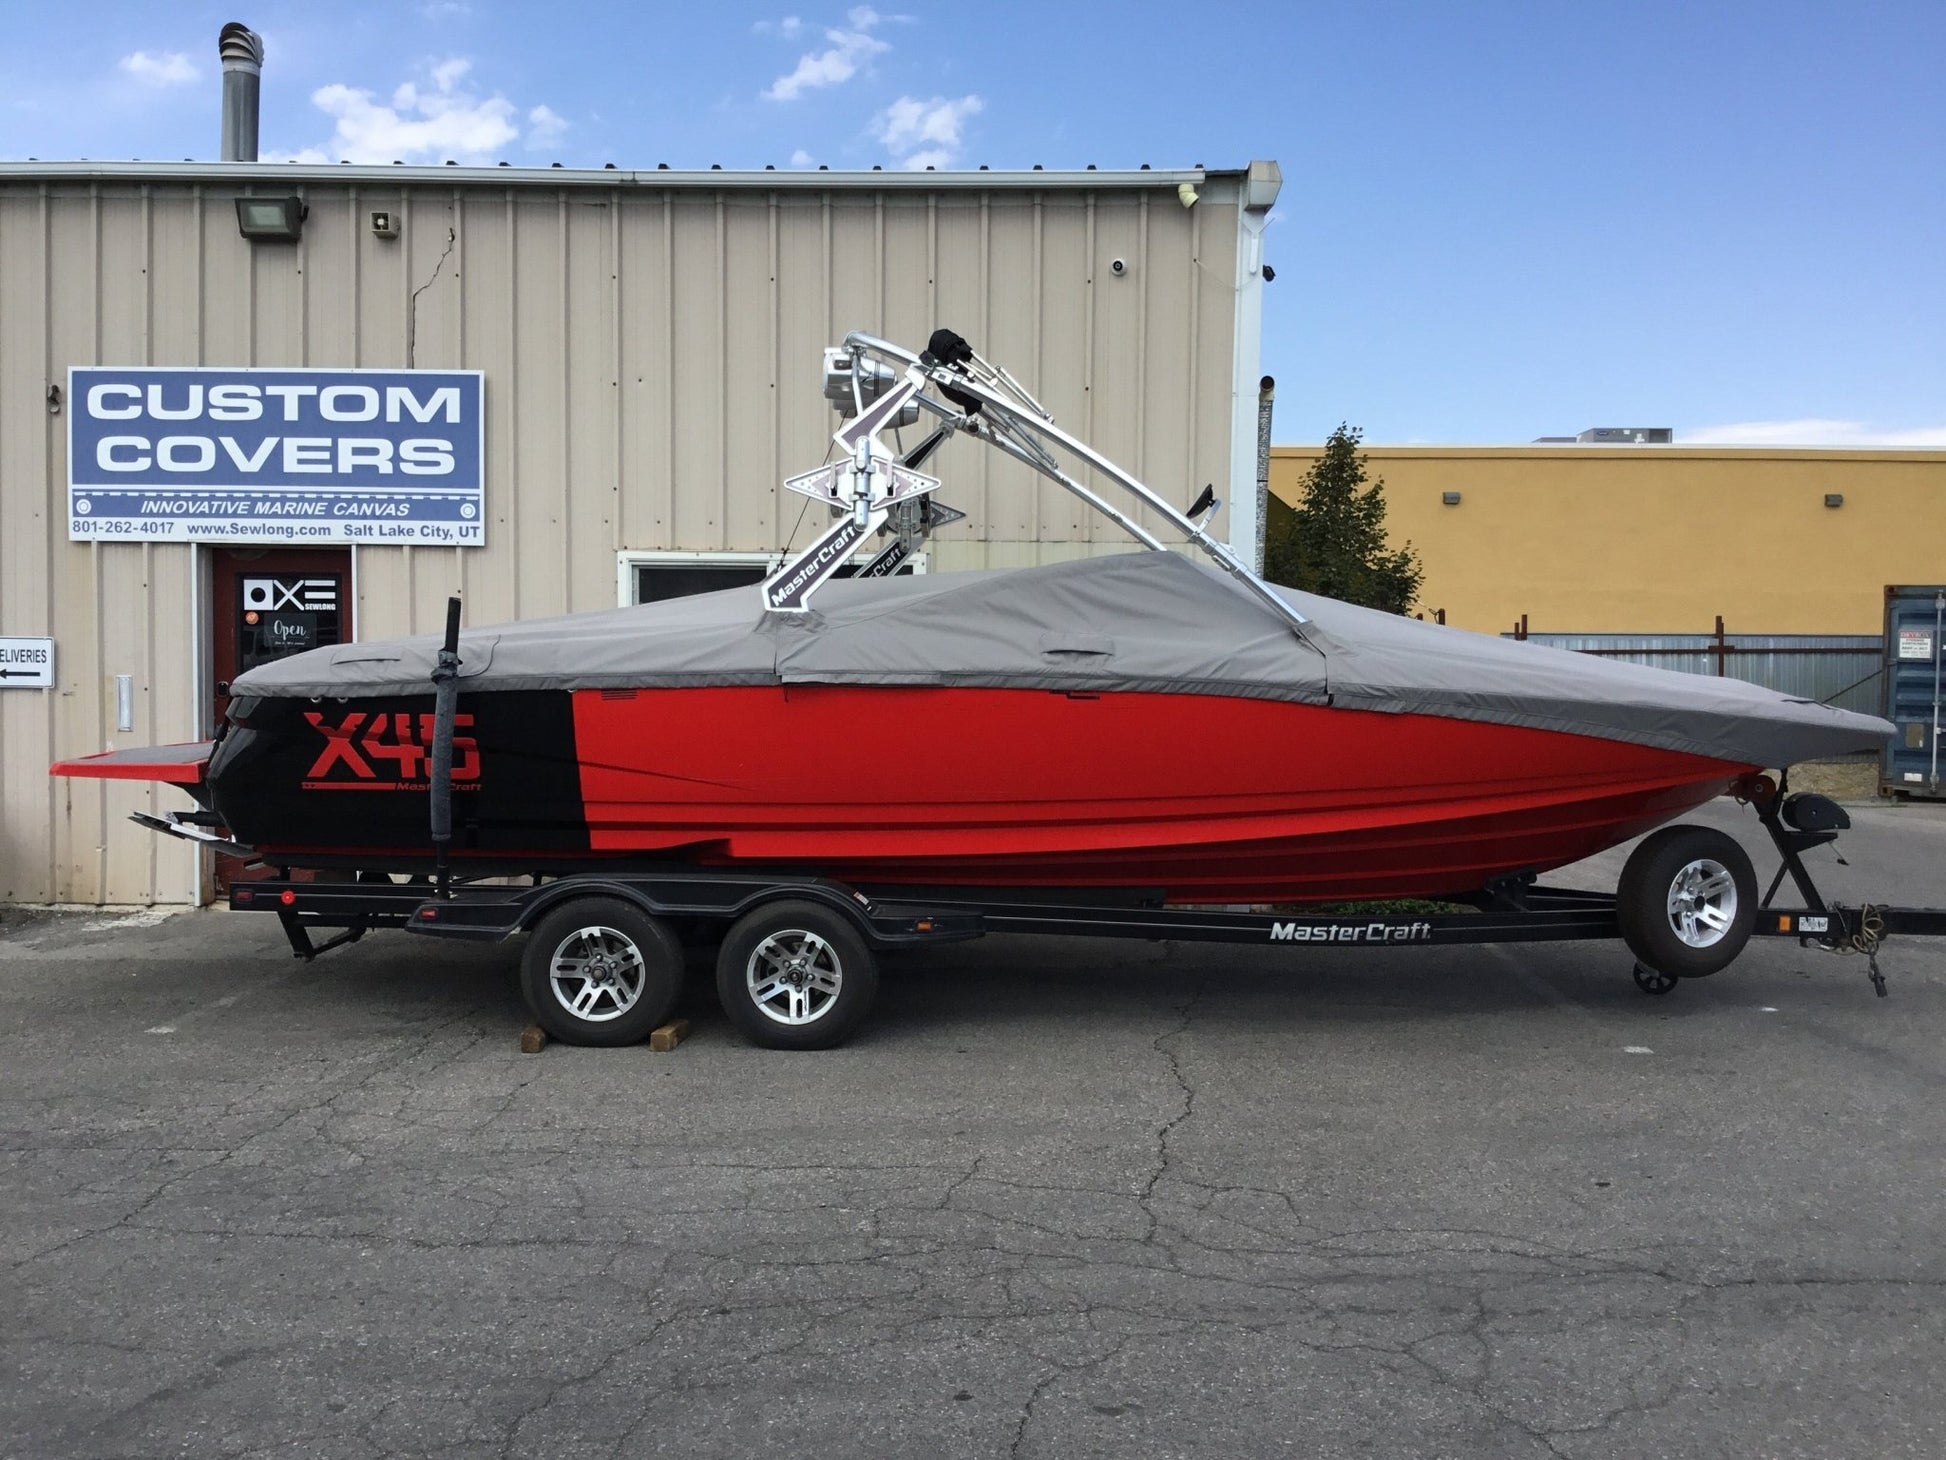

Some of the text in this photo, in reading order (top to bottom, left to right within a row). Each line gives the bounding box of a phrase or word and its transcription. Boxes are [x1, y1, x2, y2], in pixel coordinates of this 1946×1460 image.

[87, 384, 461, 423] CUSTOM
[97, 436, 456, 475] COVERS
[141, 500, 410, 516] INNOVATIVE MARINE CANVAS
[72, 520, 480, 540] 801-262-4017 www.Sewlong.com Salt Lake City, UT
[770, 526, 855, 606] MasterCraft
[274, 620, 307, 640] Open
[0, 649, 47, 663] ELIVERIES
[1270, 922, 1431, 941] MasterCraft
